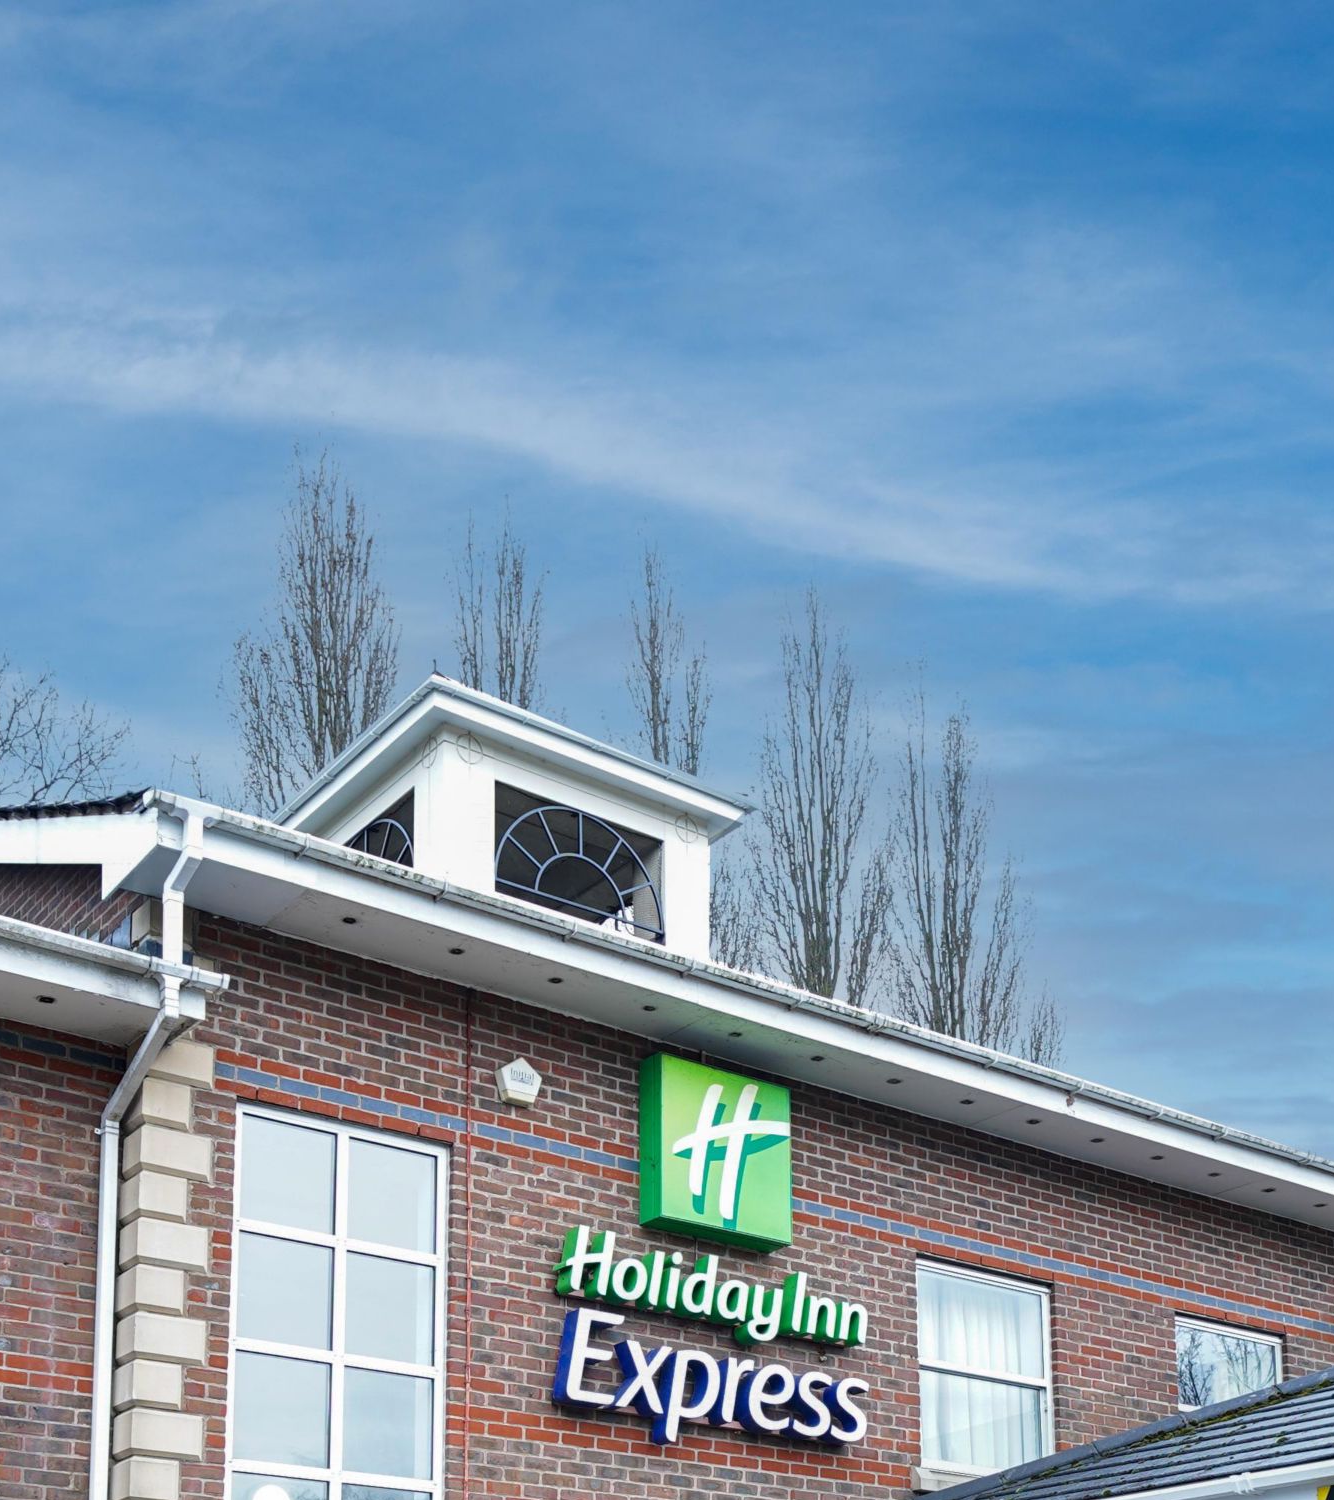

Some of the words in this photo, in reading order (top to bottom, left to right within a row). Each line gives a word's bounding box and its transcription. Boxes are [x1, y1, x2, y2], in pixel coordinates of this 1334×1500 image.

[565, 1225, 783, 1342] Holiday
[793, 1272, 868, 1344] Inn
[566, 1307, 870, 1443] Express
